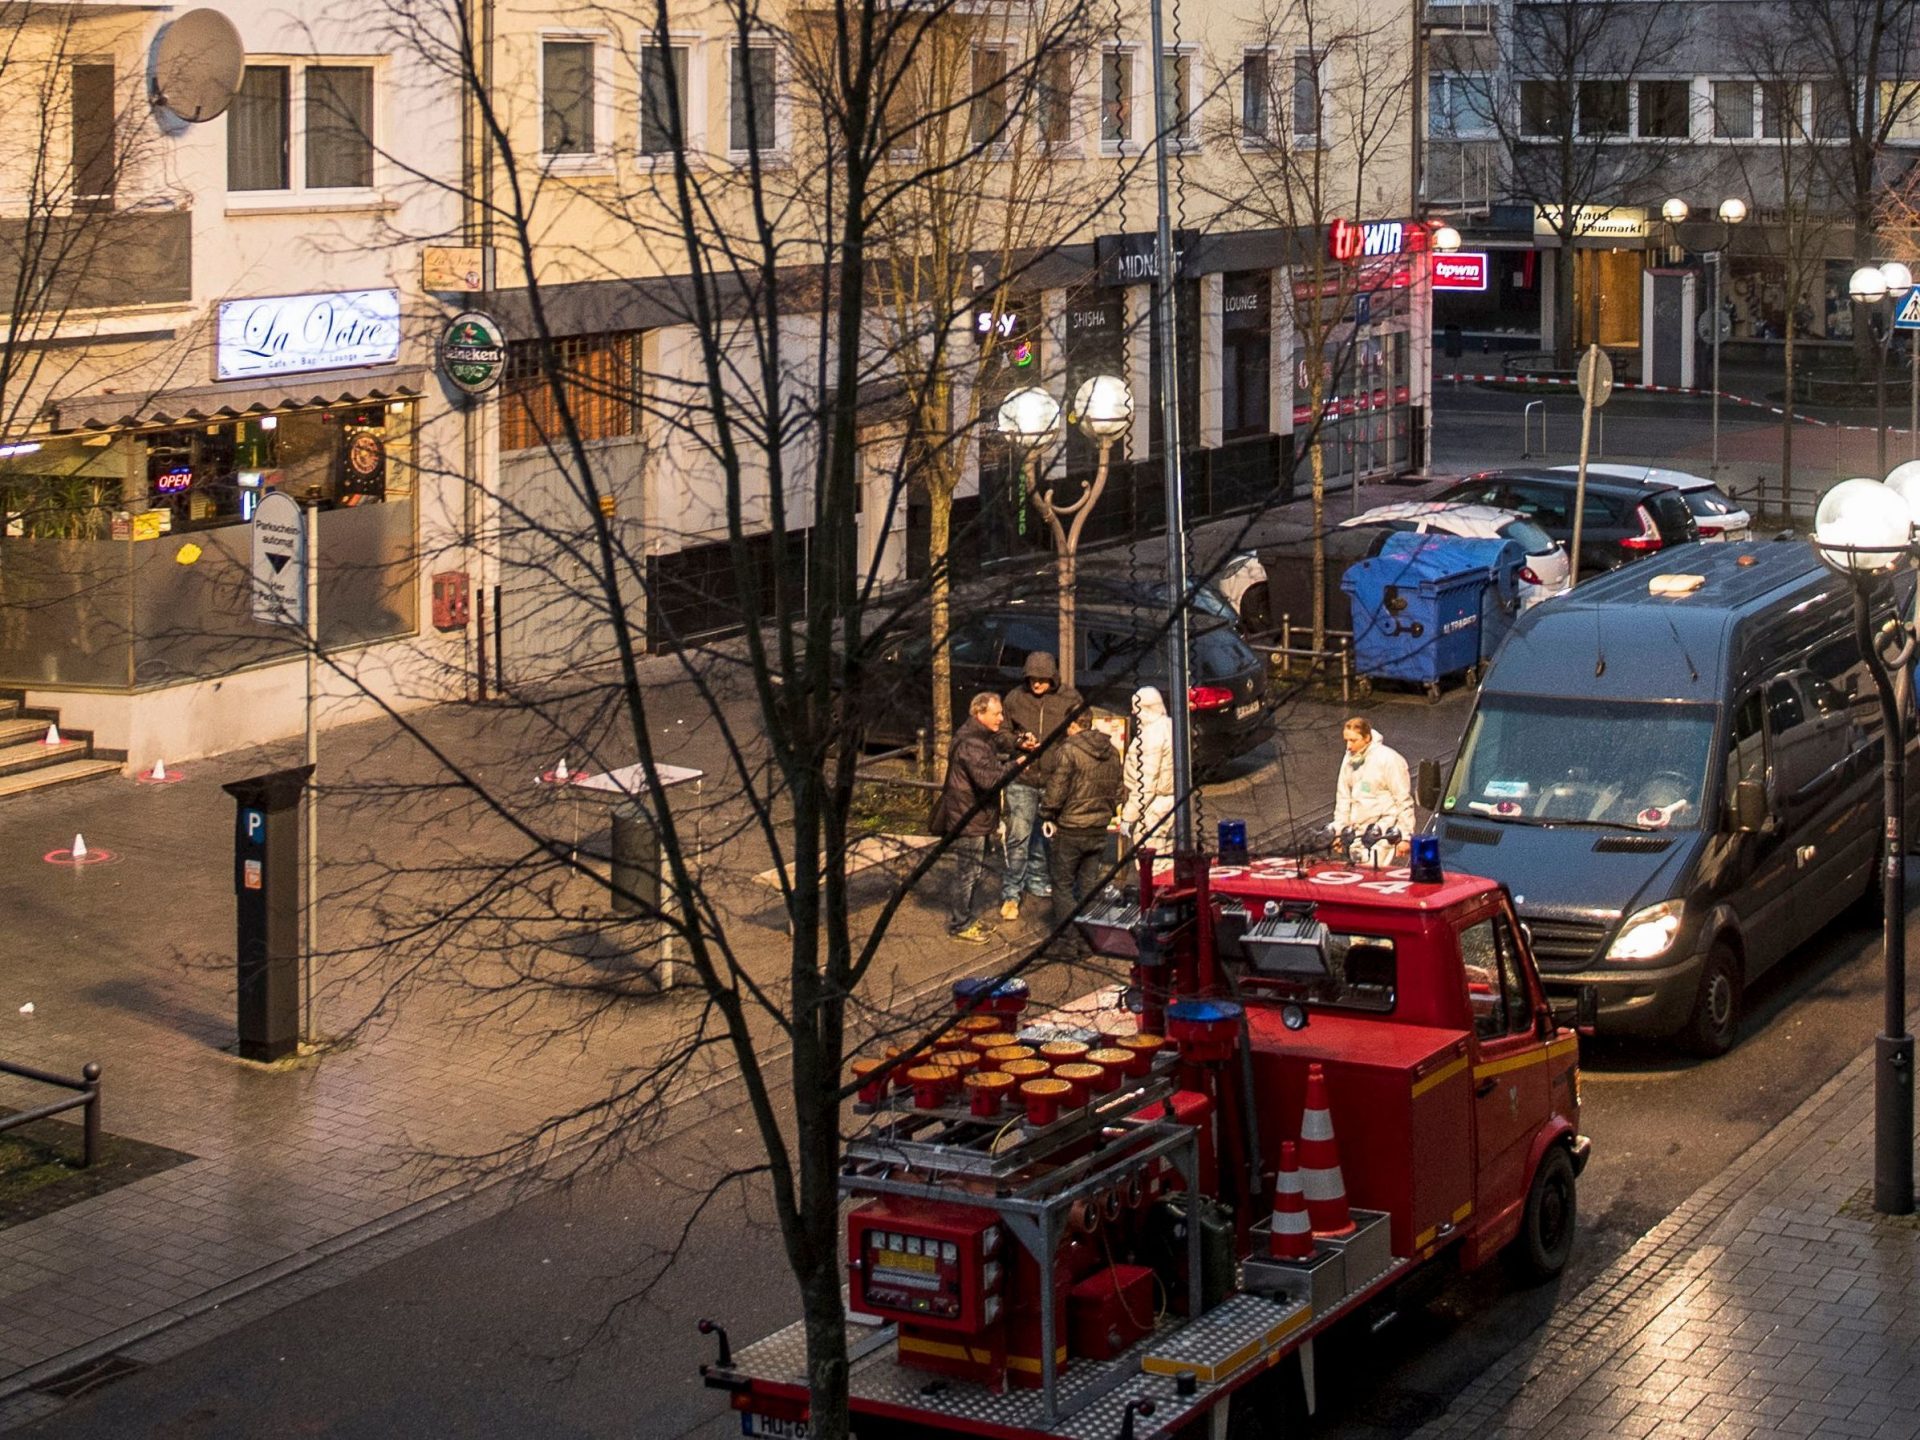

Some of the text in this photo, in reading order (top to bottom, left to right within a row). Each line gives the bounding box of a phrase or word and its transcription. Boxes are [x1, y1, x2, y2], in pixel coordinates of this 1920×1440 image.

[1436, 262, 1479, 277] tipwin
[1225, 294, 1258, 312] LOUNGE
[1073, 310, 1106, 329] SHISHA
[240, 304, 290, 358] La
[445, 347, 499, 361] eineken
[159, 473, 192, 488] OPEN
[248, 812, 261, 837] P
